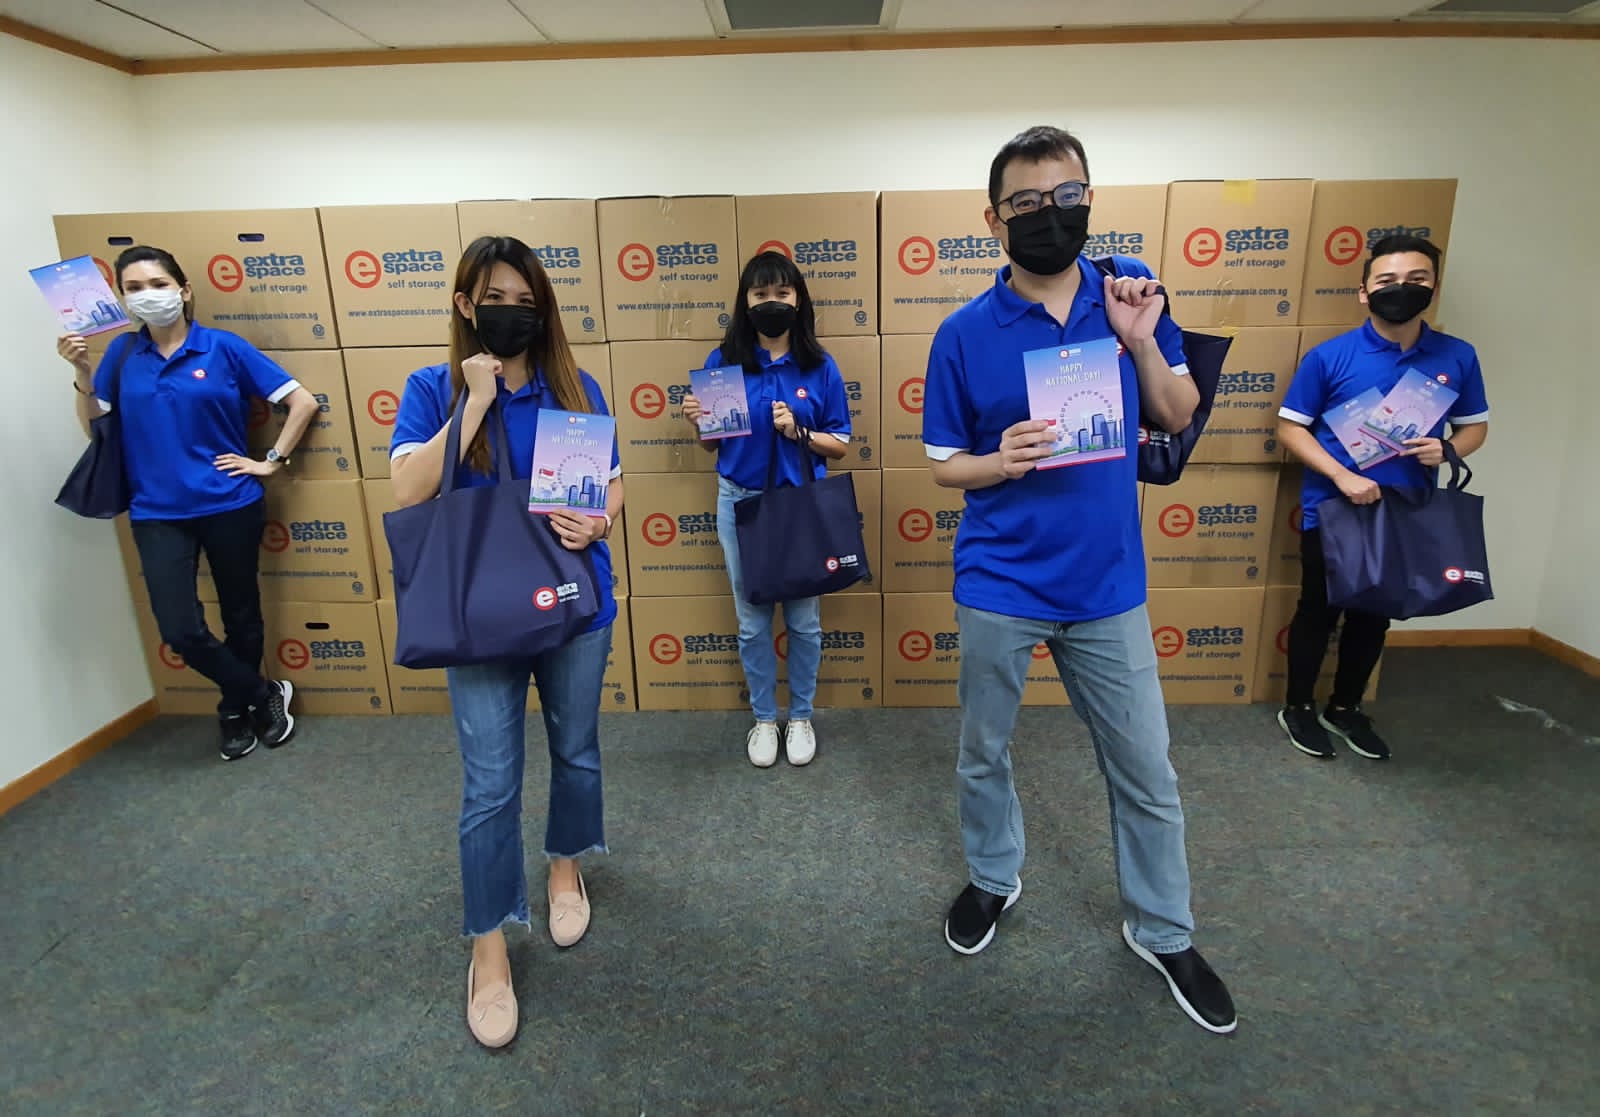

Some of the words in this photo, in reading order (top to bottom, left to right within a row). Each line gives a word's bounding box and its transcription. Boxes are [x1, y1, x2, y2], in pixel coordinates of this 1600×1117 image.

[1225, 227, 1288, 240] extra
[794, 239, 856, 252] extra
[938, 235, 1000, 248] extra
[1225, 240, 1288, 253] space
[656, 242, 717, 255] extra
[243, 252, 304, 266] extra
[382, 249, 443, 262] extra
[795, 252, 857, 265] space
[938, 249, 1000, 261] space
[543, 259, 581, 268] ace
[657, 255, 718, 268] space
[1225, 259, 1243, 267] self
[1247, 259, 1285, 268] storage
[246, 266, 305, 279] space
[384, 262, 445, 275] space
[939, 267, 957, 275] self
[660, 273, 677, 281] self
[681, 273, 718, 282] storage
[818, 271, 857, 280] storage
[388, 280, 405, 288] self
[408, 280, 446, 289] storage
[551, 277, 581, 286] orage
[249, 284, 267, 293] self
[270, 284, 307, 294] storage
[1233, 400, 1272, 409] storage
[1198, 504, 1257, 515] extra
[290, 520, 345, 531] extra
[1198, 515, 1257, 526] space
[291, 531, 347, 542] space
[1187, 626, 1243, 637] extra
[683, 633, 738, 643] extra
[1187, 637, 1243, 647] space
[310, 639, 364, 650] extra
[685, 644, 739, 654] space
[820, 641, 864, 650] pace
[311, 650, 365, 659] space
